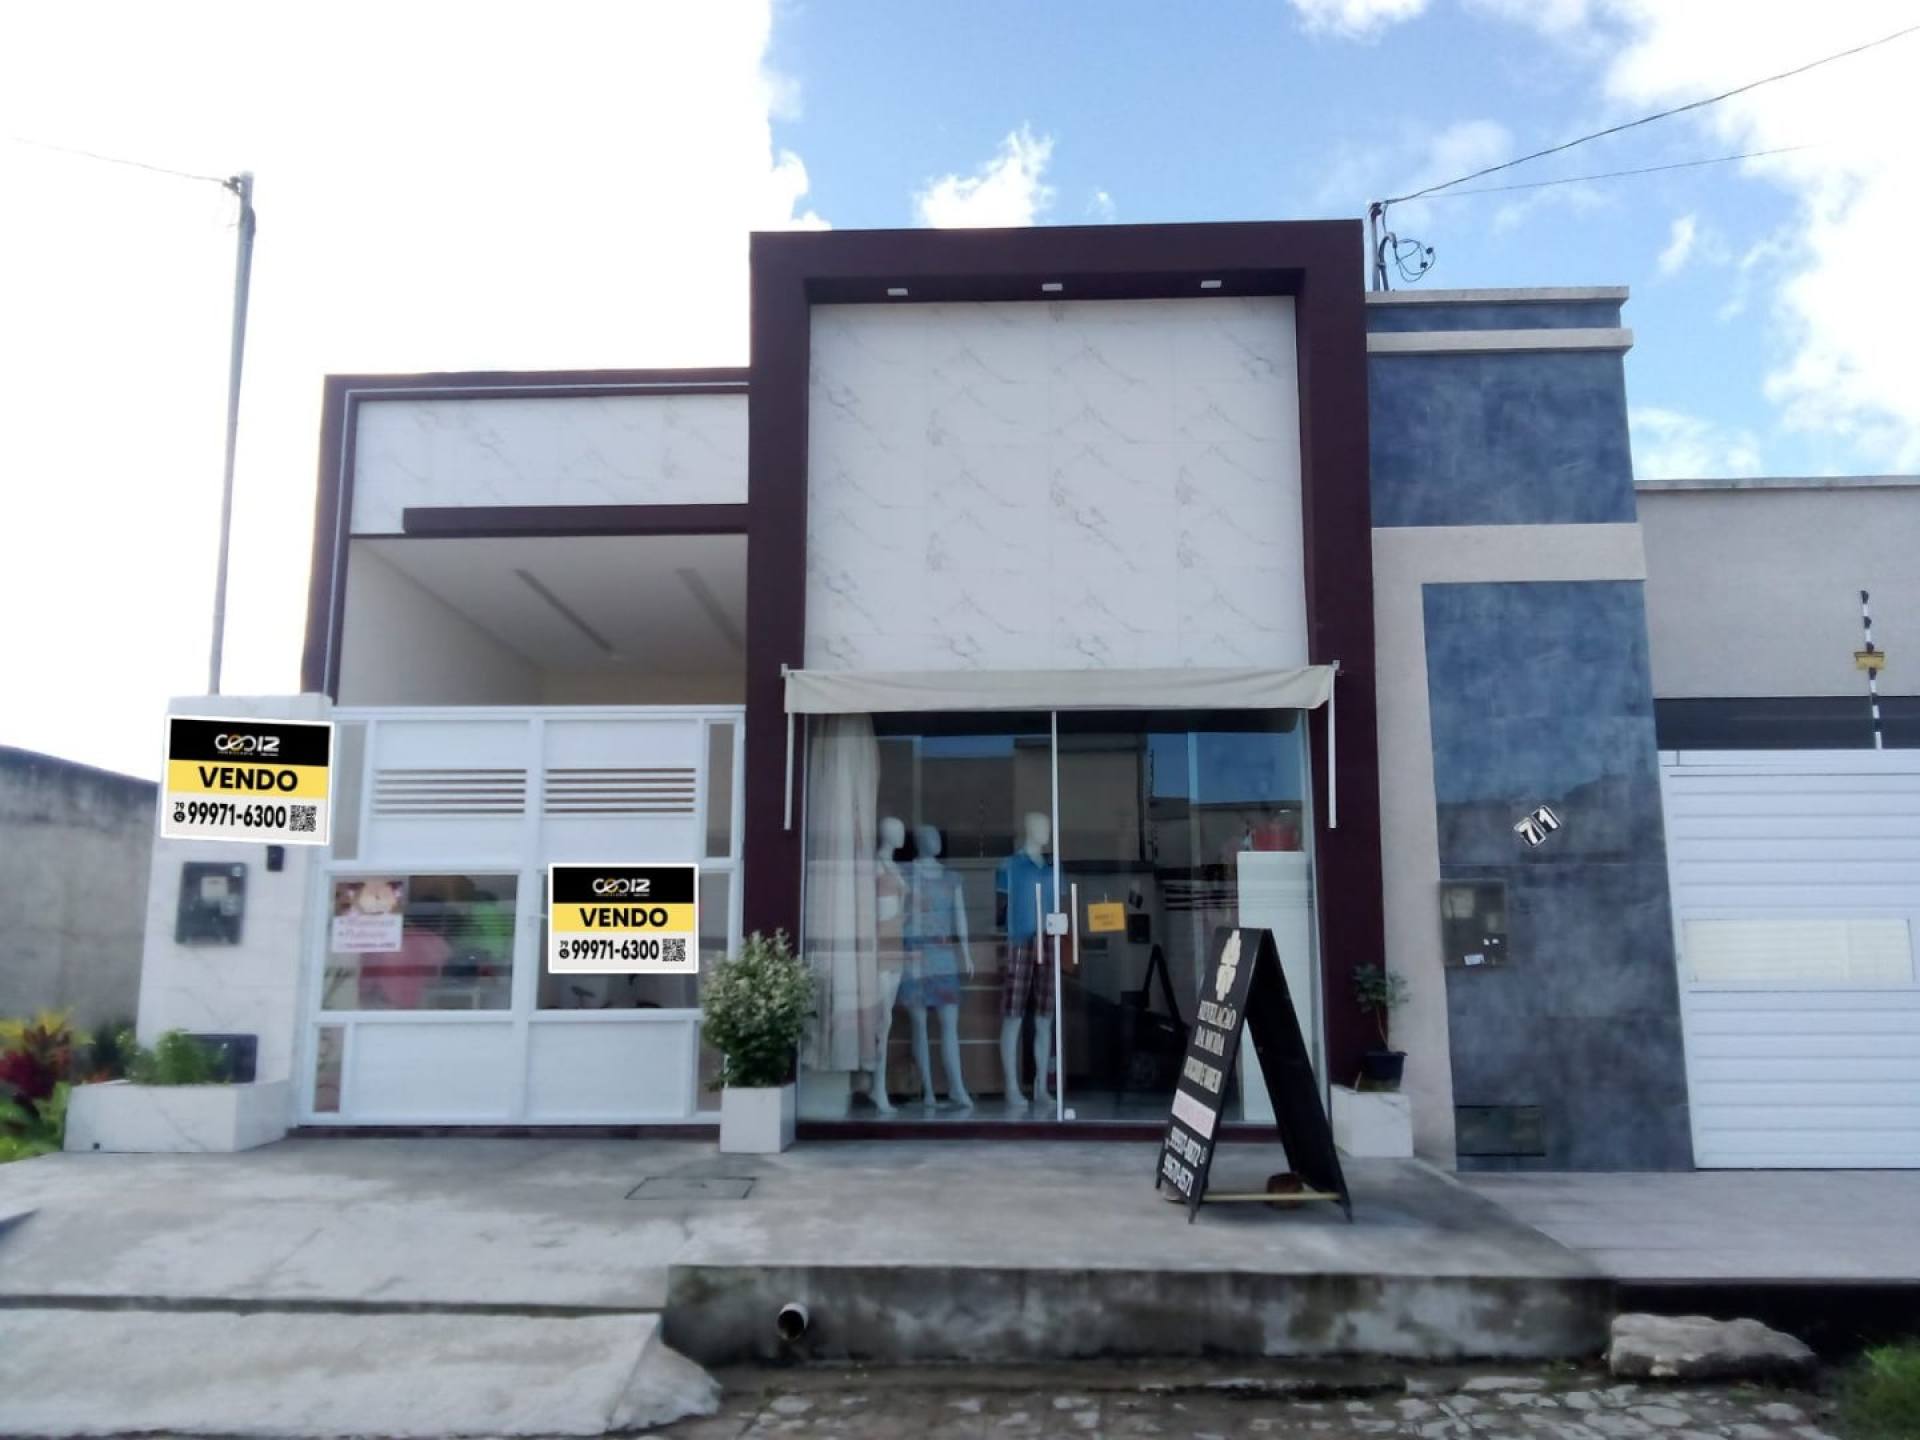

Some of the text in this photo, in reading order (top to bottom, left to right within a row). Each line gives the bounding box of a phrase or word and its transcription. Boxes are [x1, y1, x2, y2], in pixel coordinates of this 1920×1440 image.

[198, 766, 298, 792] VENDO
[188, 801, 287, 828] 99971-6300
[579, 907, 669, 928] VENDO
[571, 939, 660, 960] 99971-6300
